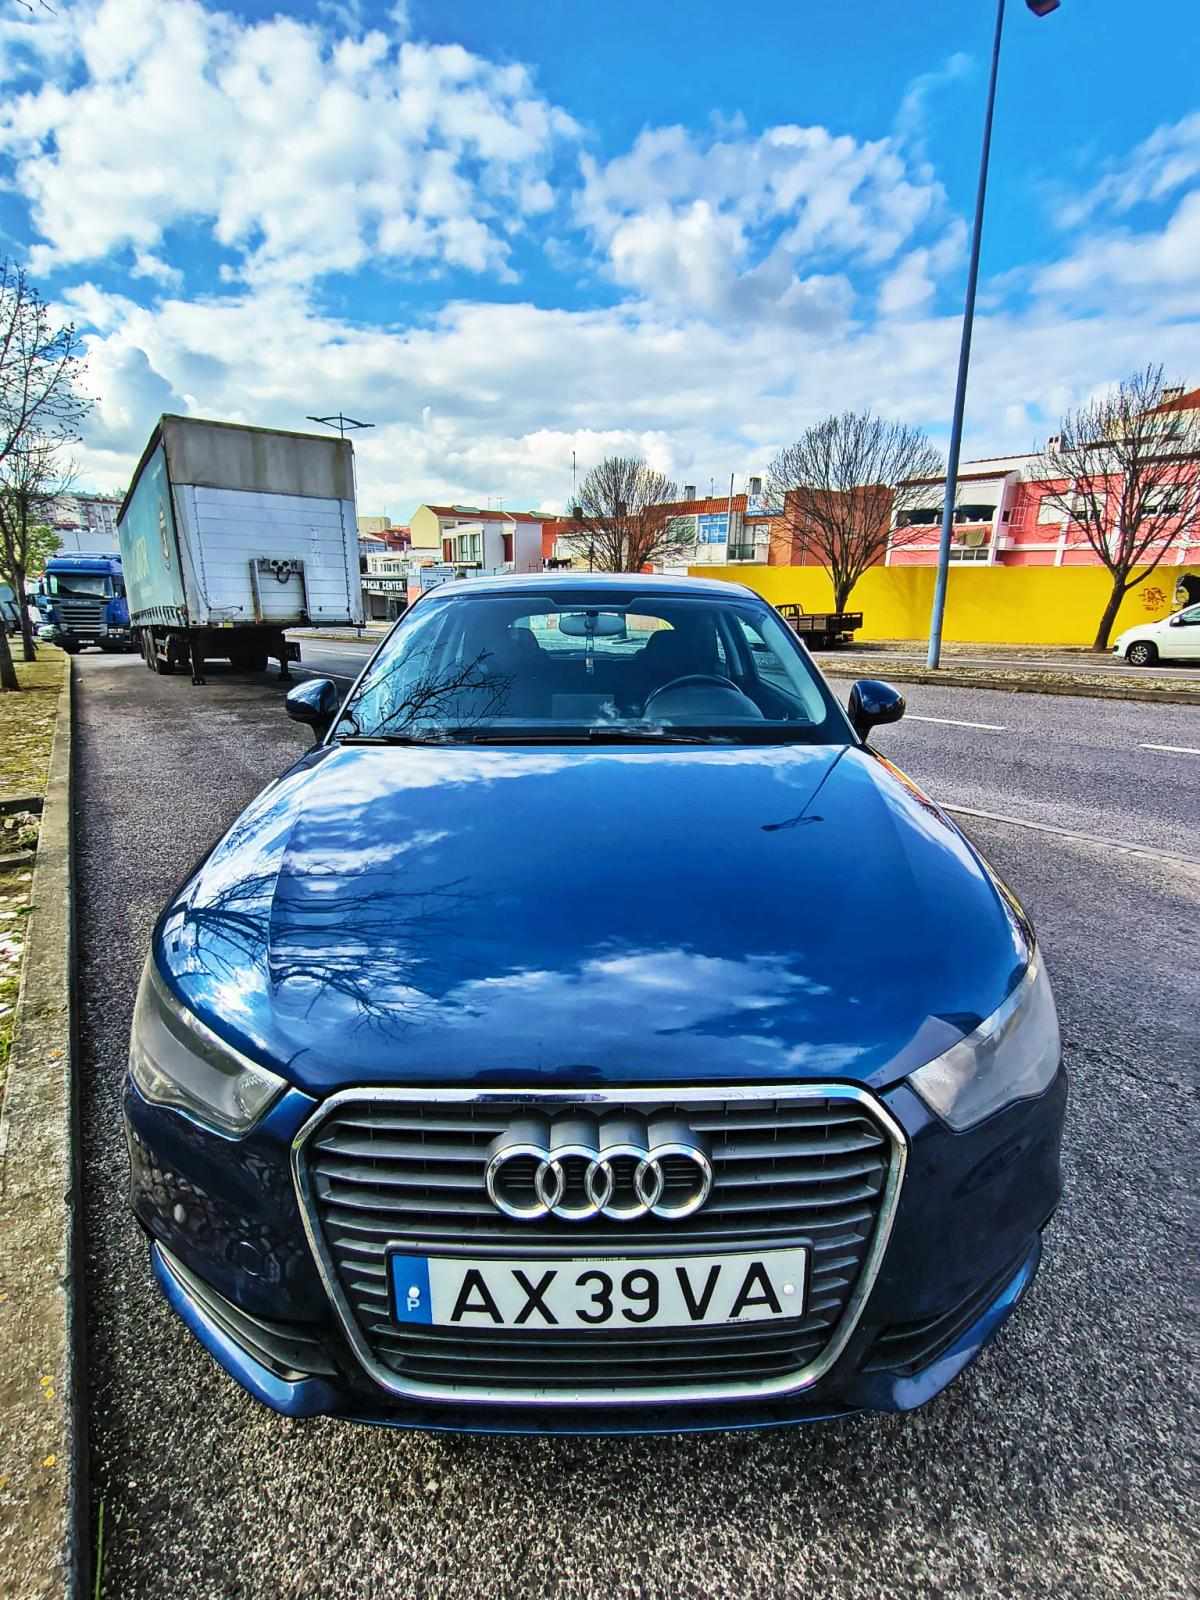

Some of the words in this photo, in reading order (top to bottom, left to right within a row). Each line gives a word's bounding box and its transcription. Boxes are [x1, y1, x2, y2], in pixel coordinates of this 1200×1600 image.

[382, 580, 404, 591] CENTER
[450, 1269, 559, 1325] AX
[575, 1269, 660, 1325] 39
[675, 1261, 783, 1321] VA
[406, 1298, 420, 1312] P
